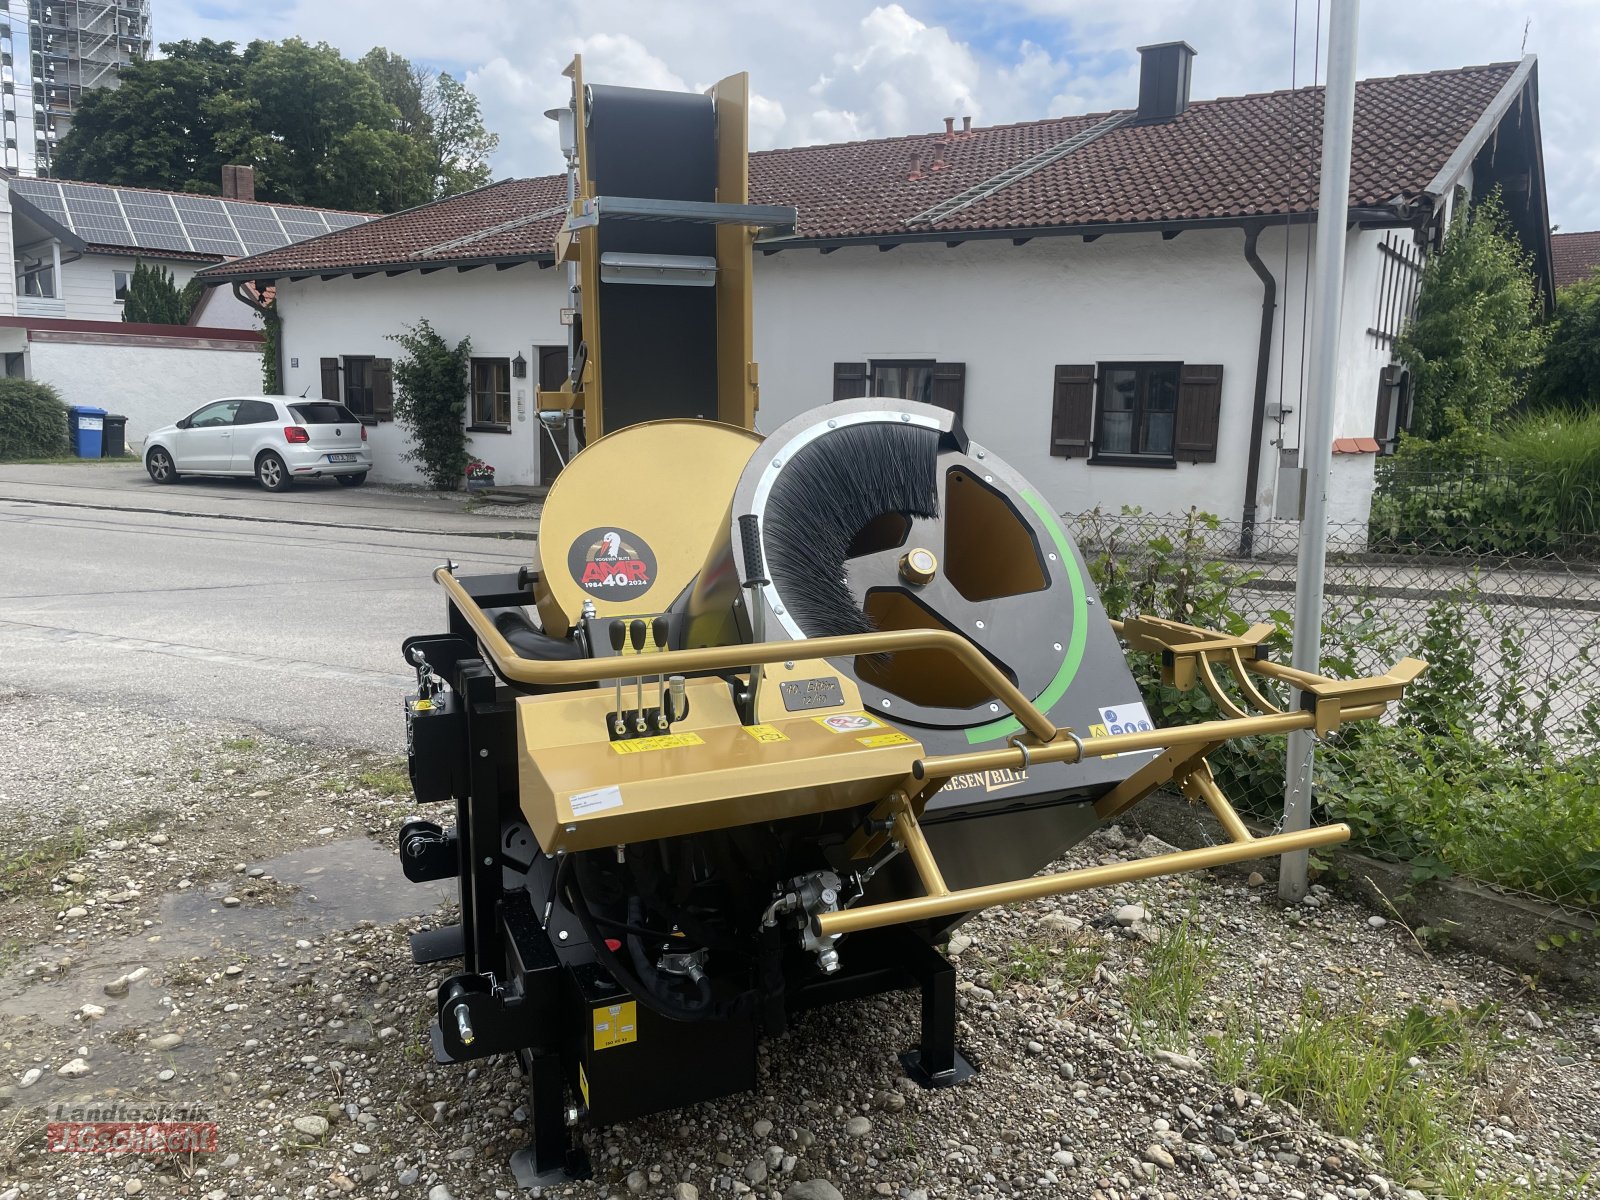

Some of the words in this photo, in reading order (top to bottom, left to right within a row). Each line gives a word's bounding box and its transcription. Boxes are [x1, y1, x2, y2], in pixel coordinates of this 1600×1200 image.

[581, 561, 650, 583] AMR
[603, 573, 628, 587] 40
[938, 772, 985, 793] GESEN
